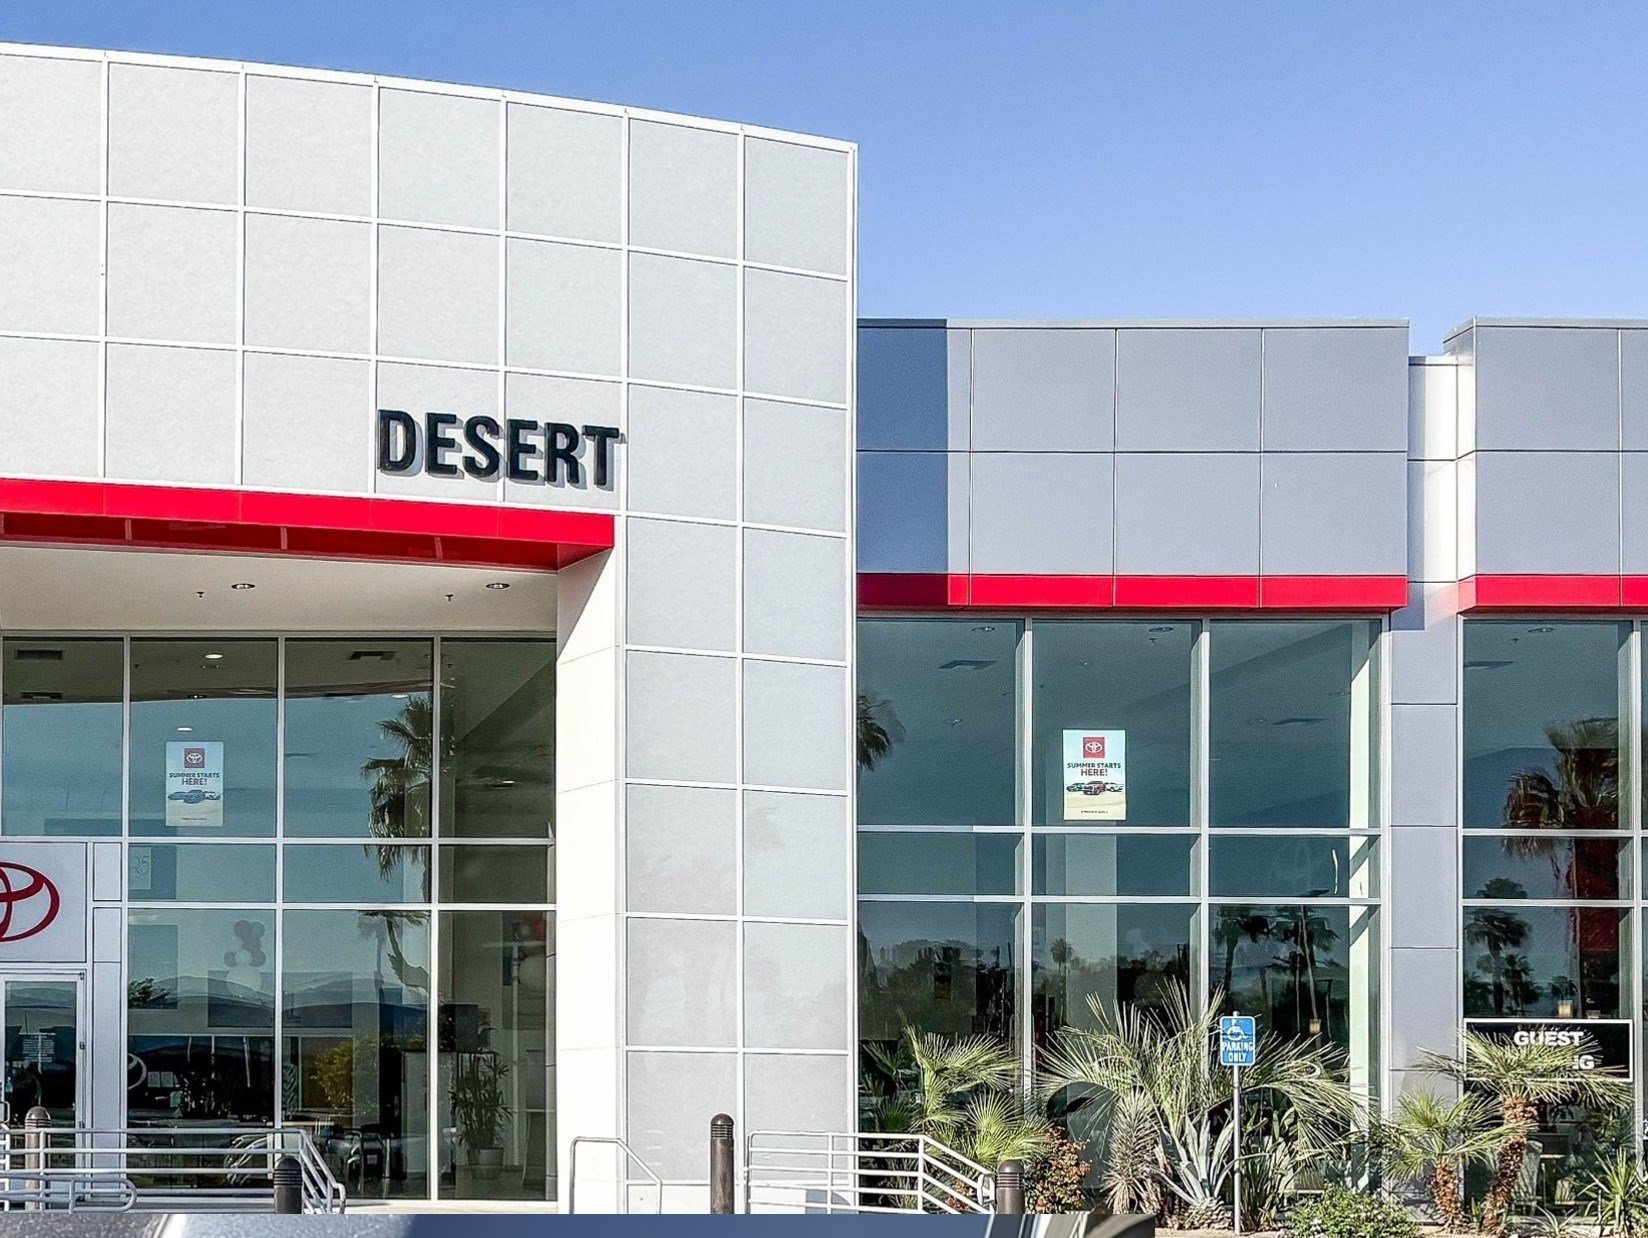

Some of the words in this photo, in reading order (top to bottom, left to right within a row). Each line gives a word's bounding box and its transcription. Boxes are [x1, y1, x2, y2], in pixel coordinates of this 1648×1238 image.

[377, 409, 620, 487] DESERT
[1080, 768, 1108, 776] HERE!
[181, 778, 208, 786] HERE!
[1513, 1030, 1584, 1047] GUEST
[1222, 1041, 1254, 1051] PARKING
[1228, 1052, 1248, 1062] ONLY
